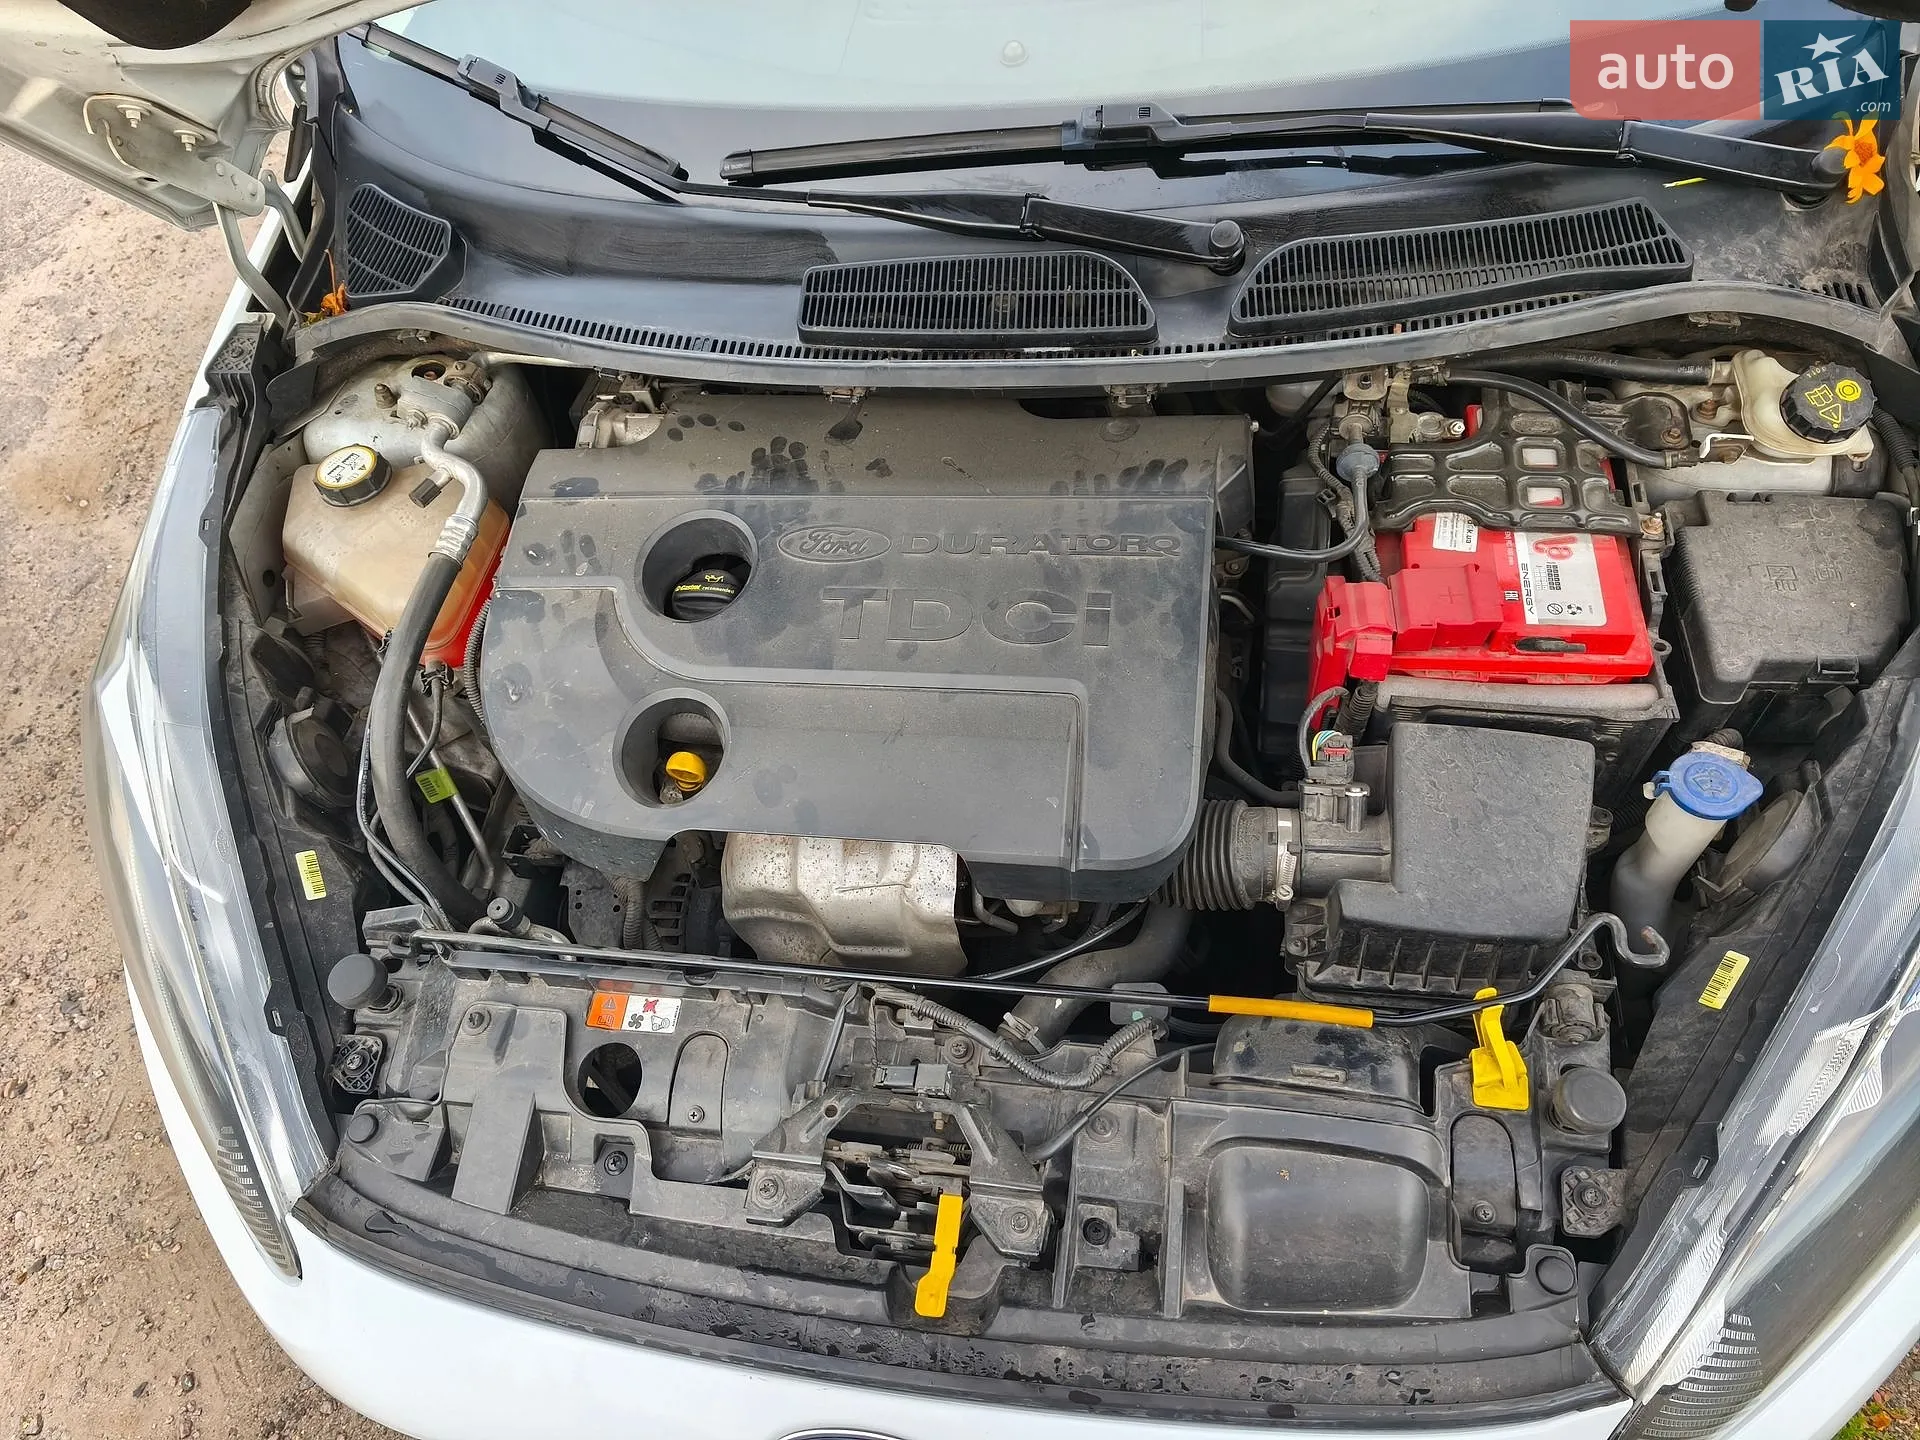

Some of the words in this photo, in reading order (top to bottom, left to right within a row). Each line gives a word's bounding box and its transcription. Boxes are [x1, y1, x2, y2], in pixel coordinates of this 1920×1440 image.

[799, 529, 870, 557] Ford
[899, 531, 1183, 559] DURATORQ
[1520, 562, 1537, 616] ENERGY
